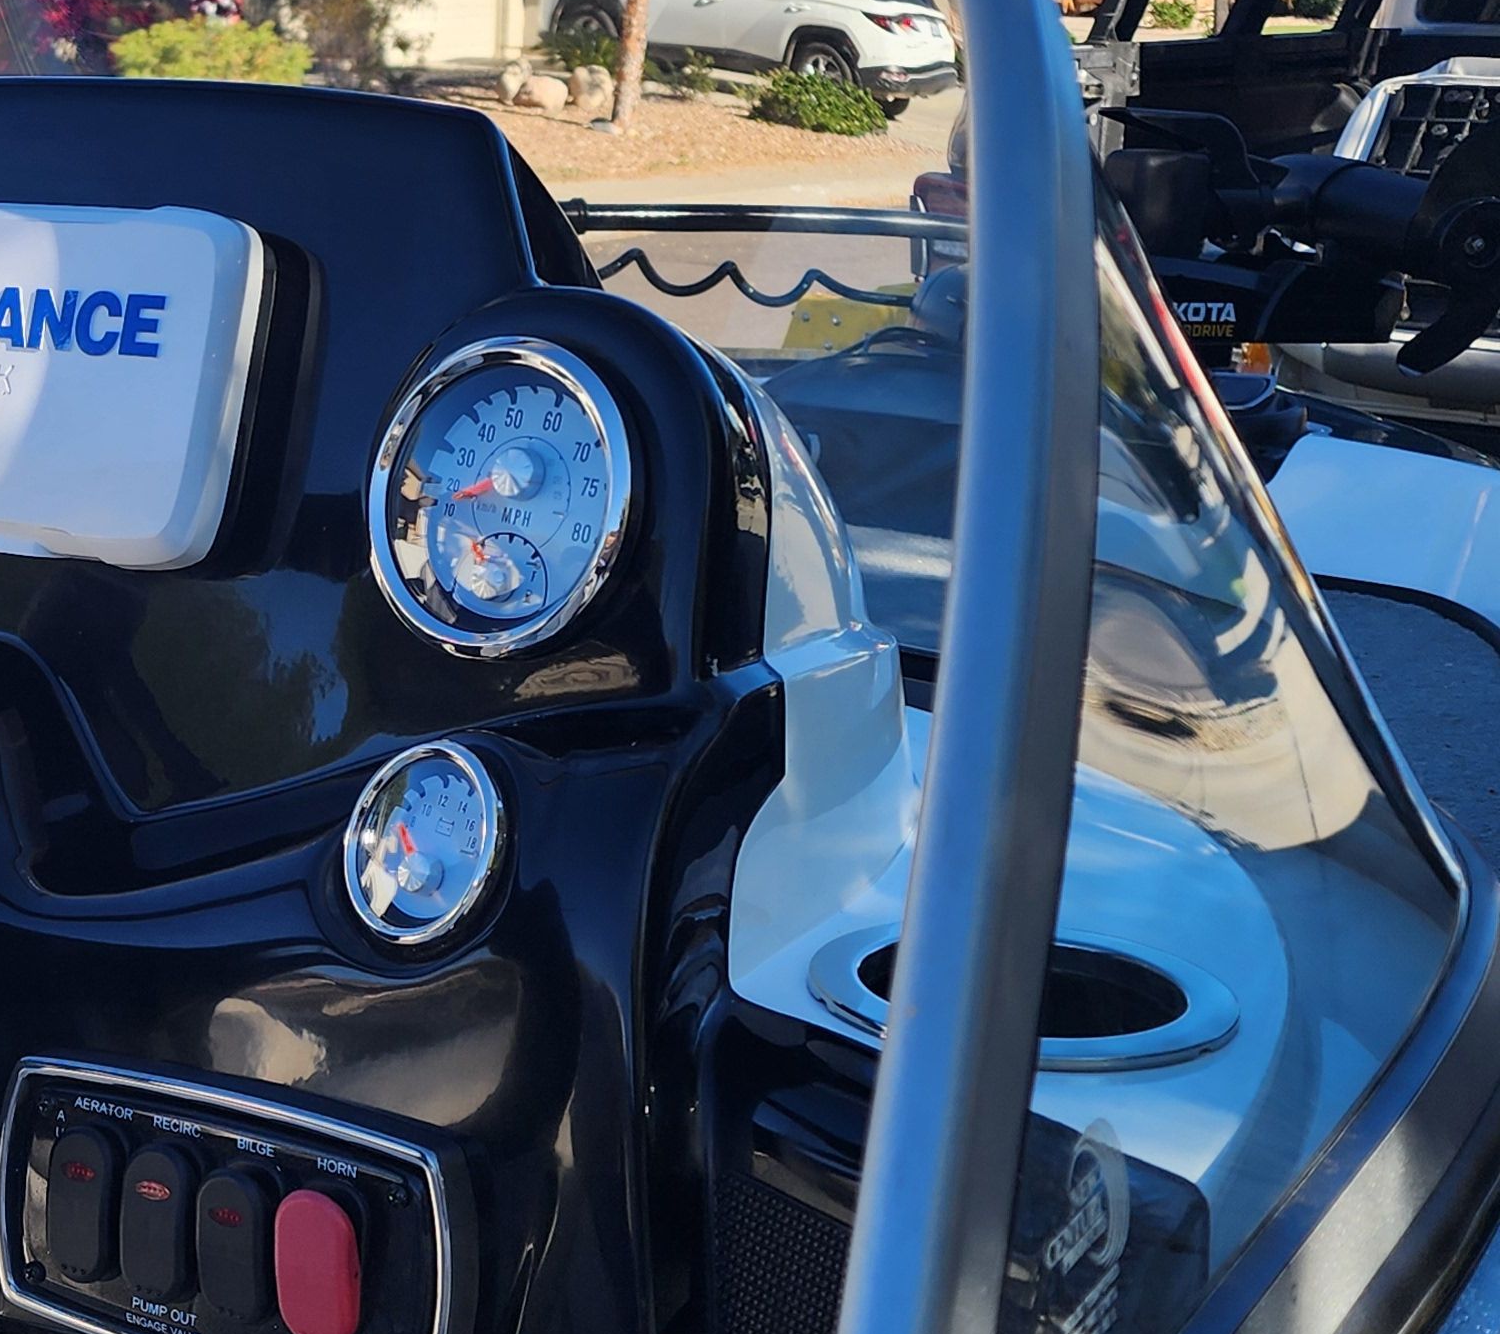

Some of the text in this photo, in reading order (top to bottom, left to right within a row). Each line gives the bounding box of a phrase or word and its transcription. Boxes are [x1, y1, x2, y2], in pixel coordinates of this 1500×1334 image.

[504, 407, 523, 429] 50
[542, 410, 562, 432] 60
[477, 422, 495, 443] 40
[456, 447, 475, 467] 30
[572, 441, 591, 462] 70
[446, 477, 460, 492] 20
[580, 477, 599, 497] 75
[443, 502, 455, 517] 10
[501, 506, 532, 527] MPH
[570, 522, 591, 544] 80
[420, 802, 432, 817] 10
[437, 793, 448, 807] 12
[457, 800, 467, 813] 14
[464, 818, 474, 831] 16
[467, 835, 477, 849] 18
[74, 1095, 134, 1121] AERATOR
[236, 1136, 276, 1158] BILGE
[317, 1156, 358, 1179] HORN
[131, 1295, 197, 1327] PUMP OUT
[125, 1312, 168, 1334] ENGAGE
